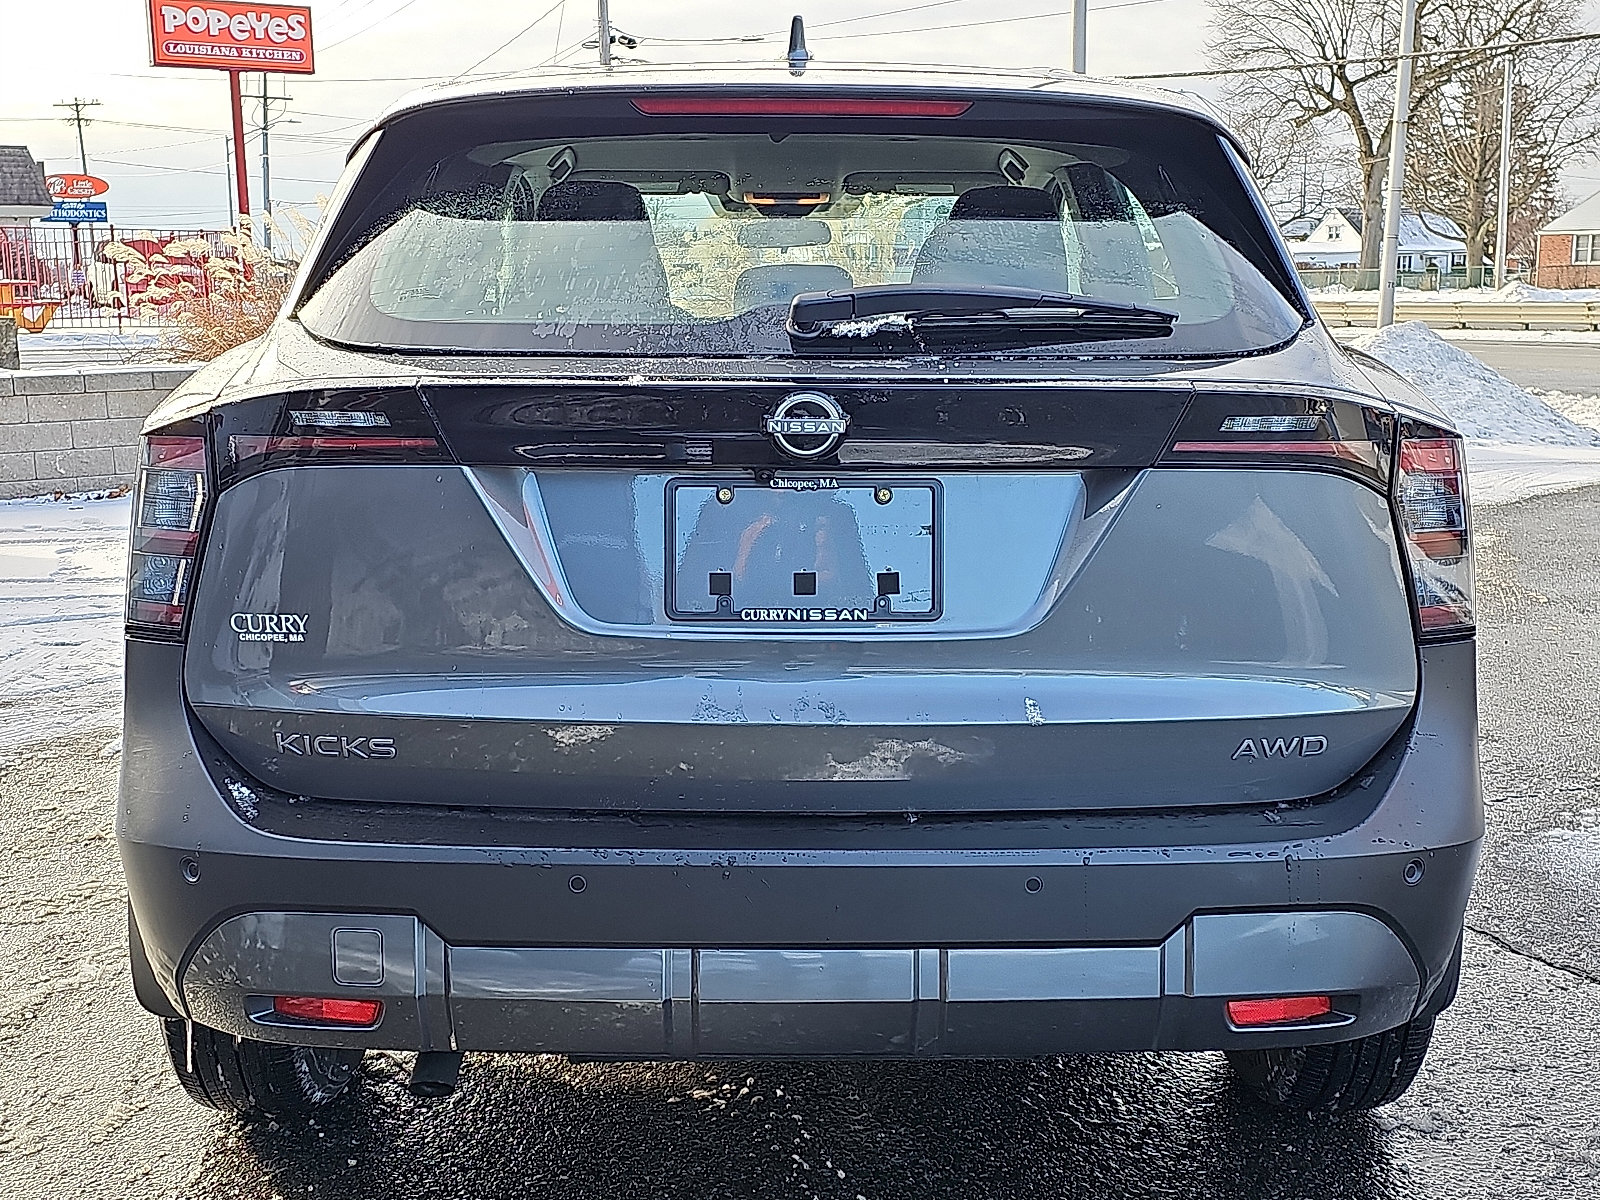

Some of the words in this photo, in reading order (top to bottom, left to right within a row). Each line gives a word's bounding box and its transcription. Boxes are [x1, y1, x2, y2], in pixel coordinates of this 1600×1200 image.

[168, 43, 239, 57] LOUISIANA
[240, 47, 301, 61] KITCHEN
[73, 179, 93, 189] Little
[769, 421, 844, 432] NISSAN
[769, 479, 817, 490] Chicopee,
[819, 479, 839, 488] MA
[230, 613, 309, 634] CURRY
[239, 633, 288, 643] CHICOPEE,
[289, 633, 305, 642] MA
[275, 732, 396, 759] KICKS
[1230, 735, 1328, 760] AWD
